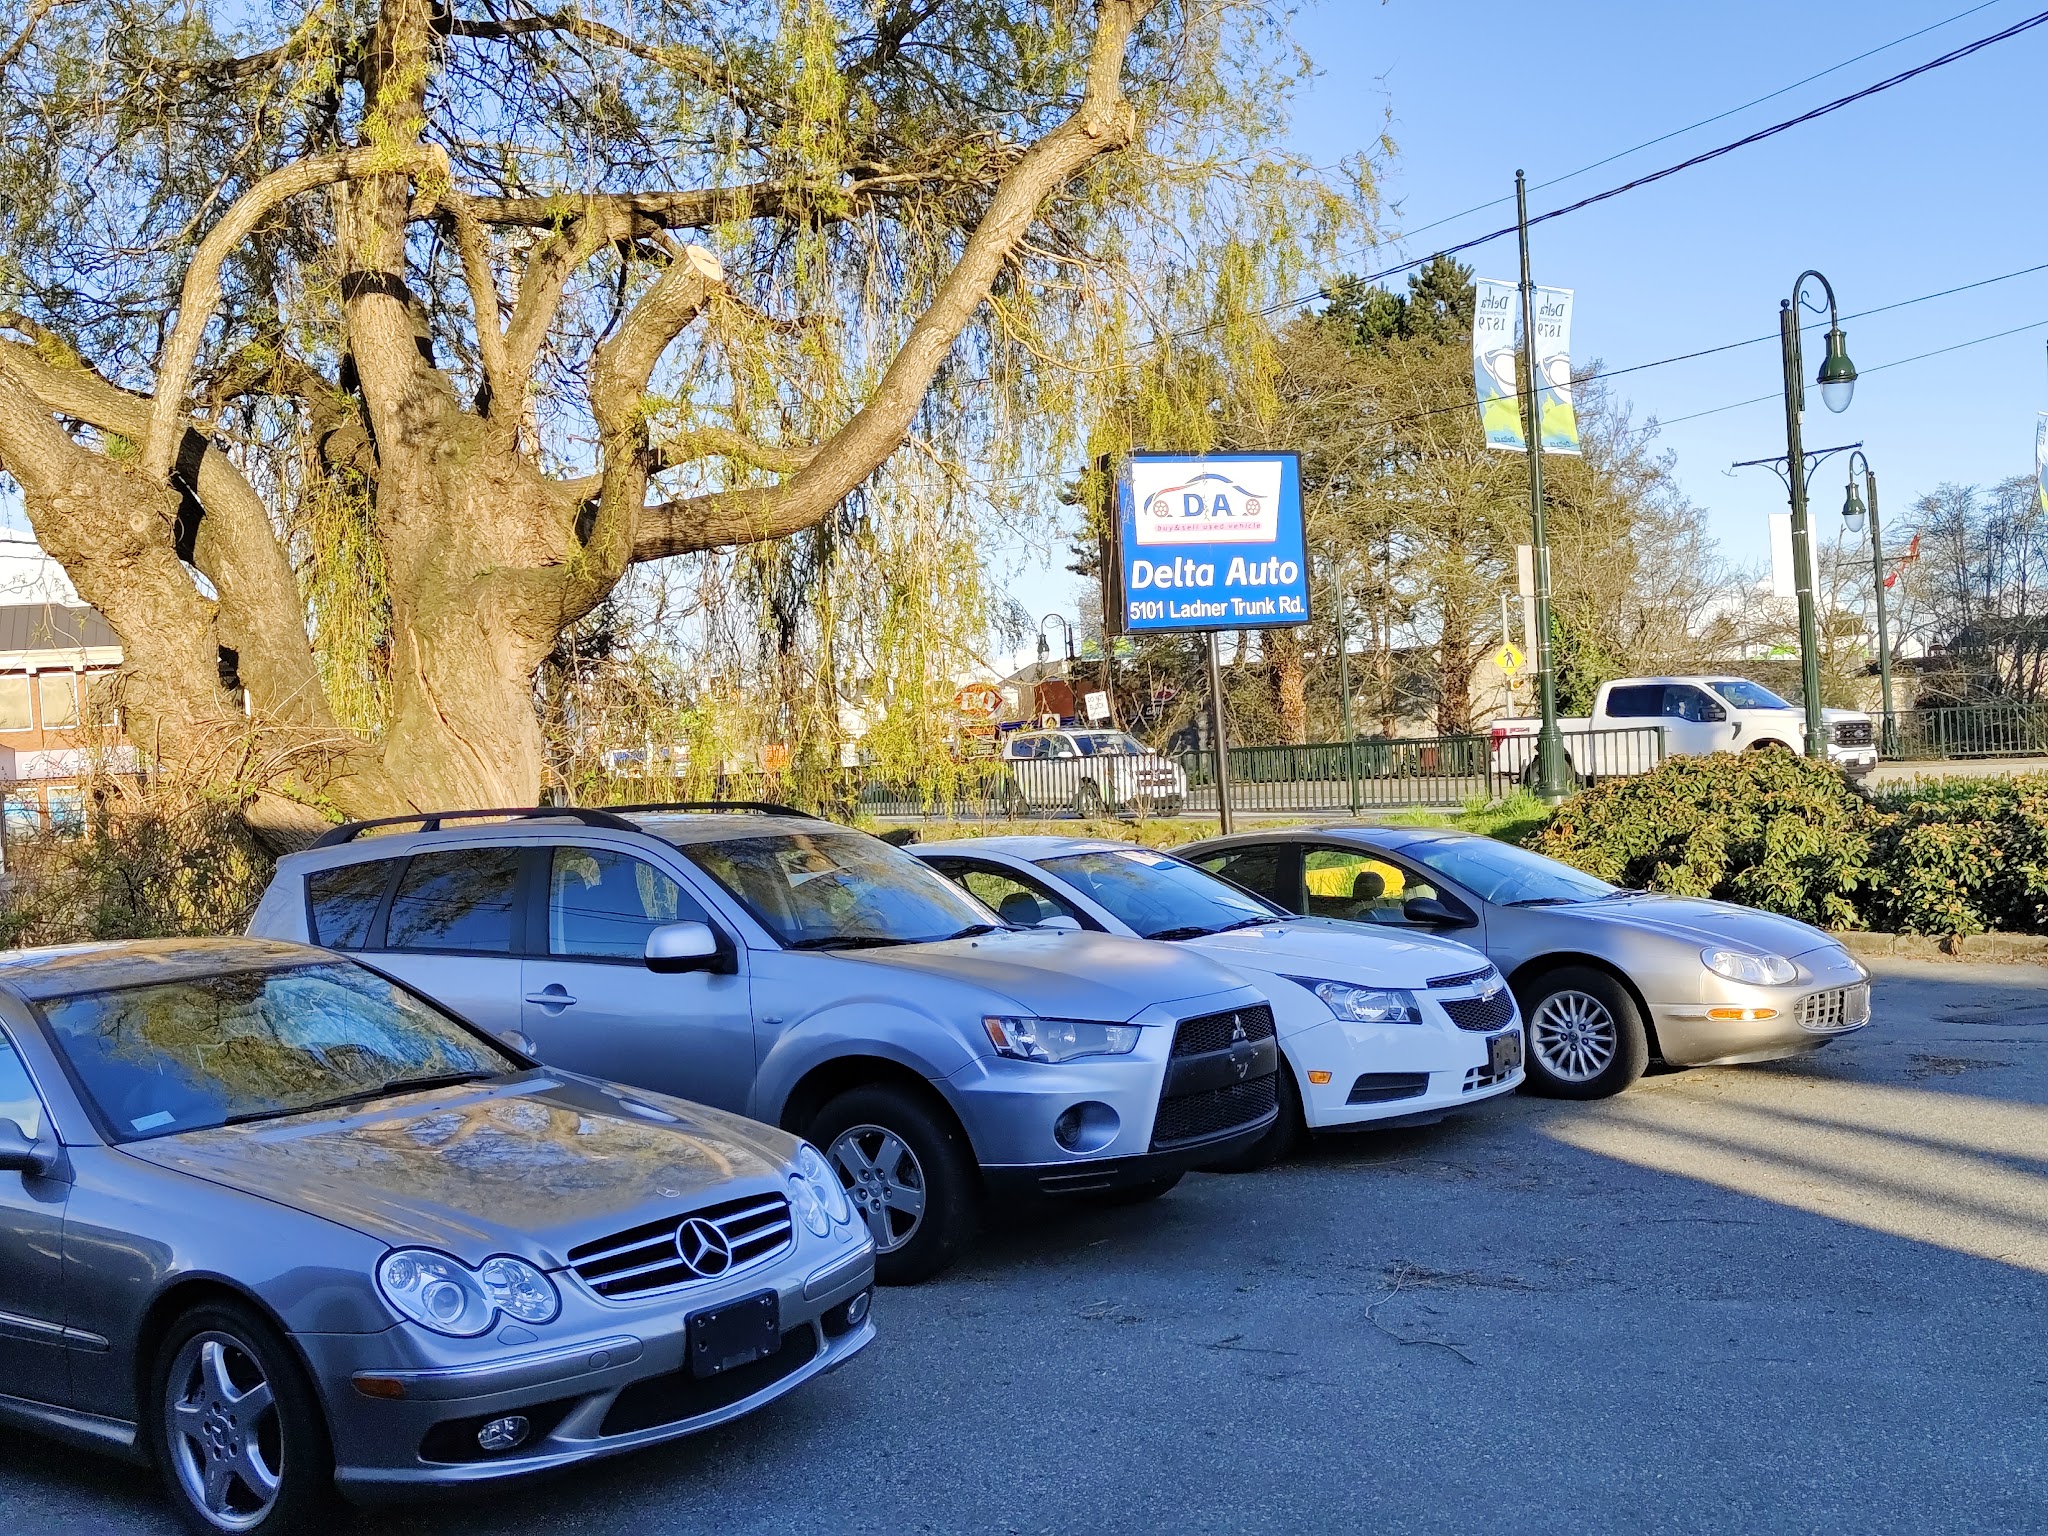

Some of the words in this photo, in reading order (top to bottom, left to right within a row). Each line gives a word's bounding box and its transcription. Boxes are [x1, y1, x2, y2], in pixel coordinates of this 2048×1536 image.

[1157, 524, 1199, 532] buy&sell
[1131, 556, 1215, 589] Delta
[1225, 556, 1299, 586] Auto
[1130, 600, 1164, 620] 5101
[1169, 599, 1228, 619] Ladner
[1230, 597, 1275, 616] Trunk
[1279, 595, 1305, 614] Rd.
